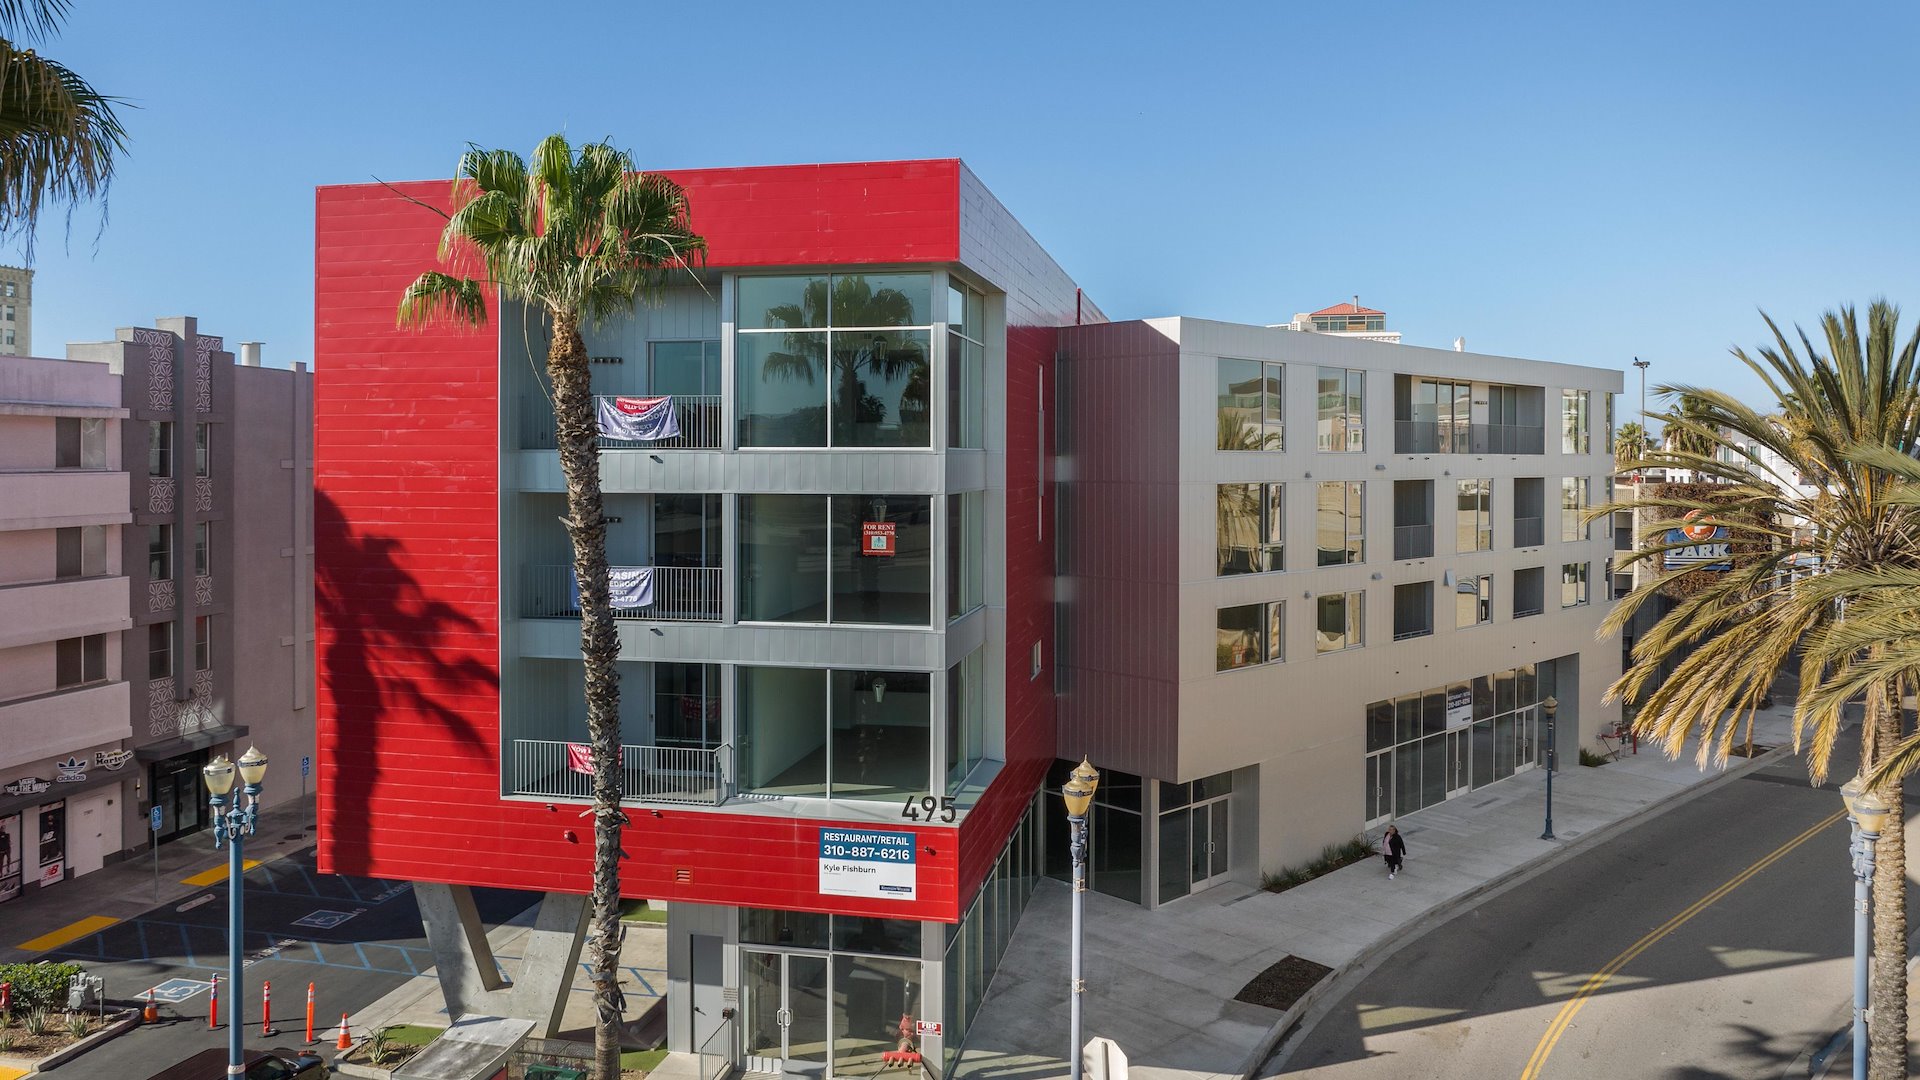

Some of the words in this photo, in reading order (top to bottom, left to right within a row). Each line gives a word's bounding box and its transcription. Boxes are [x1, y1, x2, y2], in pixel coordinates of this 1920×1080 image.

[1669, 543, 1729, 558] PARK
[96, 751, 133, 765] Martens
[19, 783, 32, 792] THE
[901, 795, 957, 823] 495
[824, 832, 909, 846] RESTAURANT/RETAIL
[823, 844, 910, 860] 310-887-6216
[823, 864, 841, 873] Kyle
[842, 865, 876, 874] Fishburn
